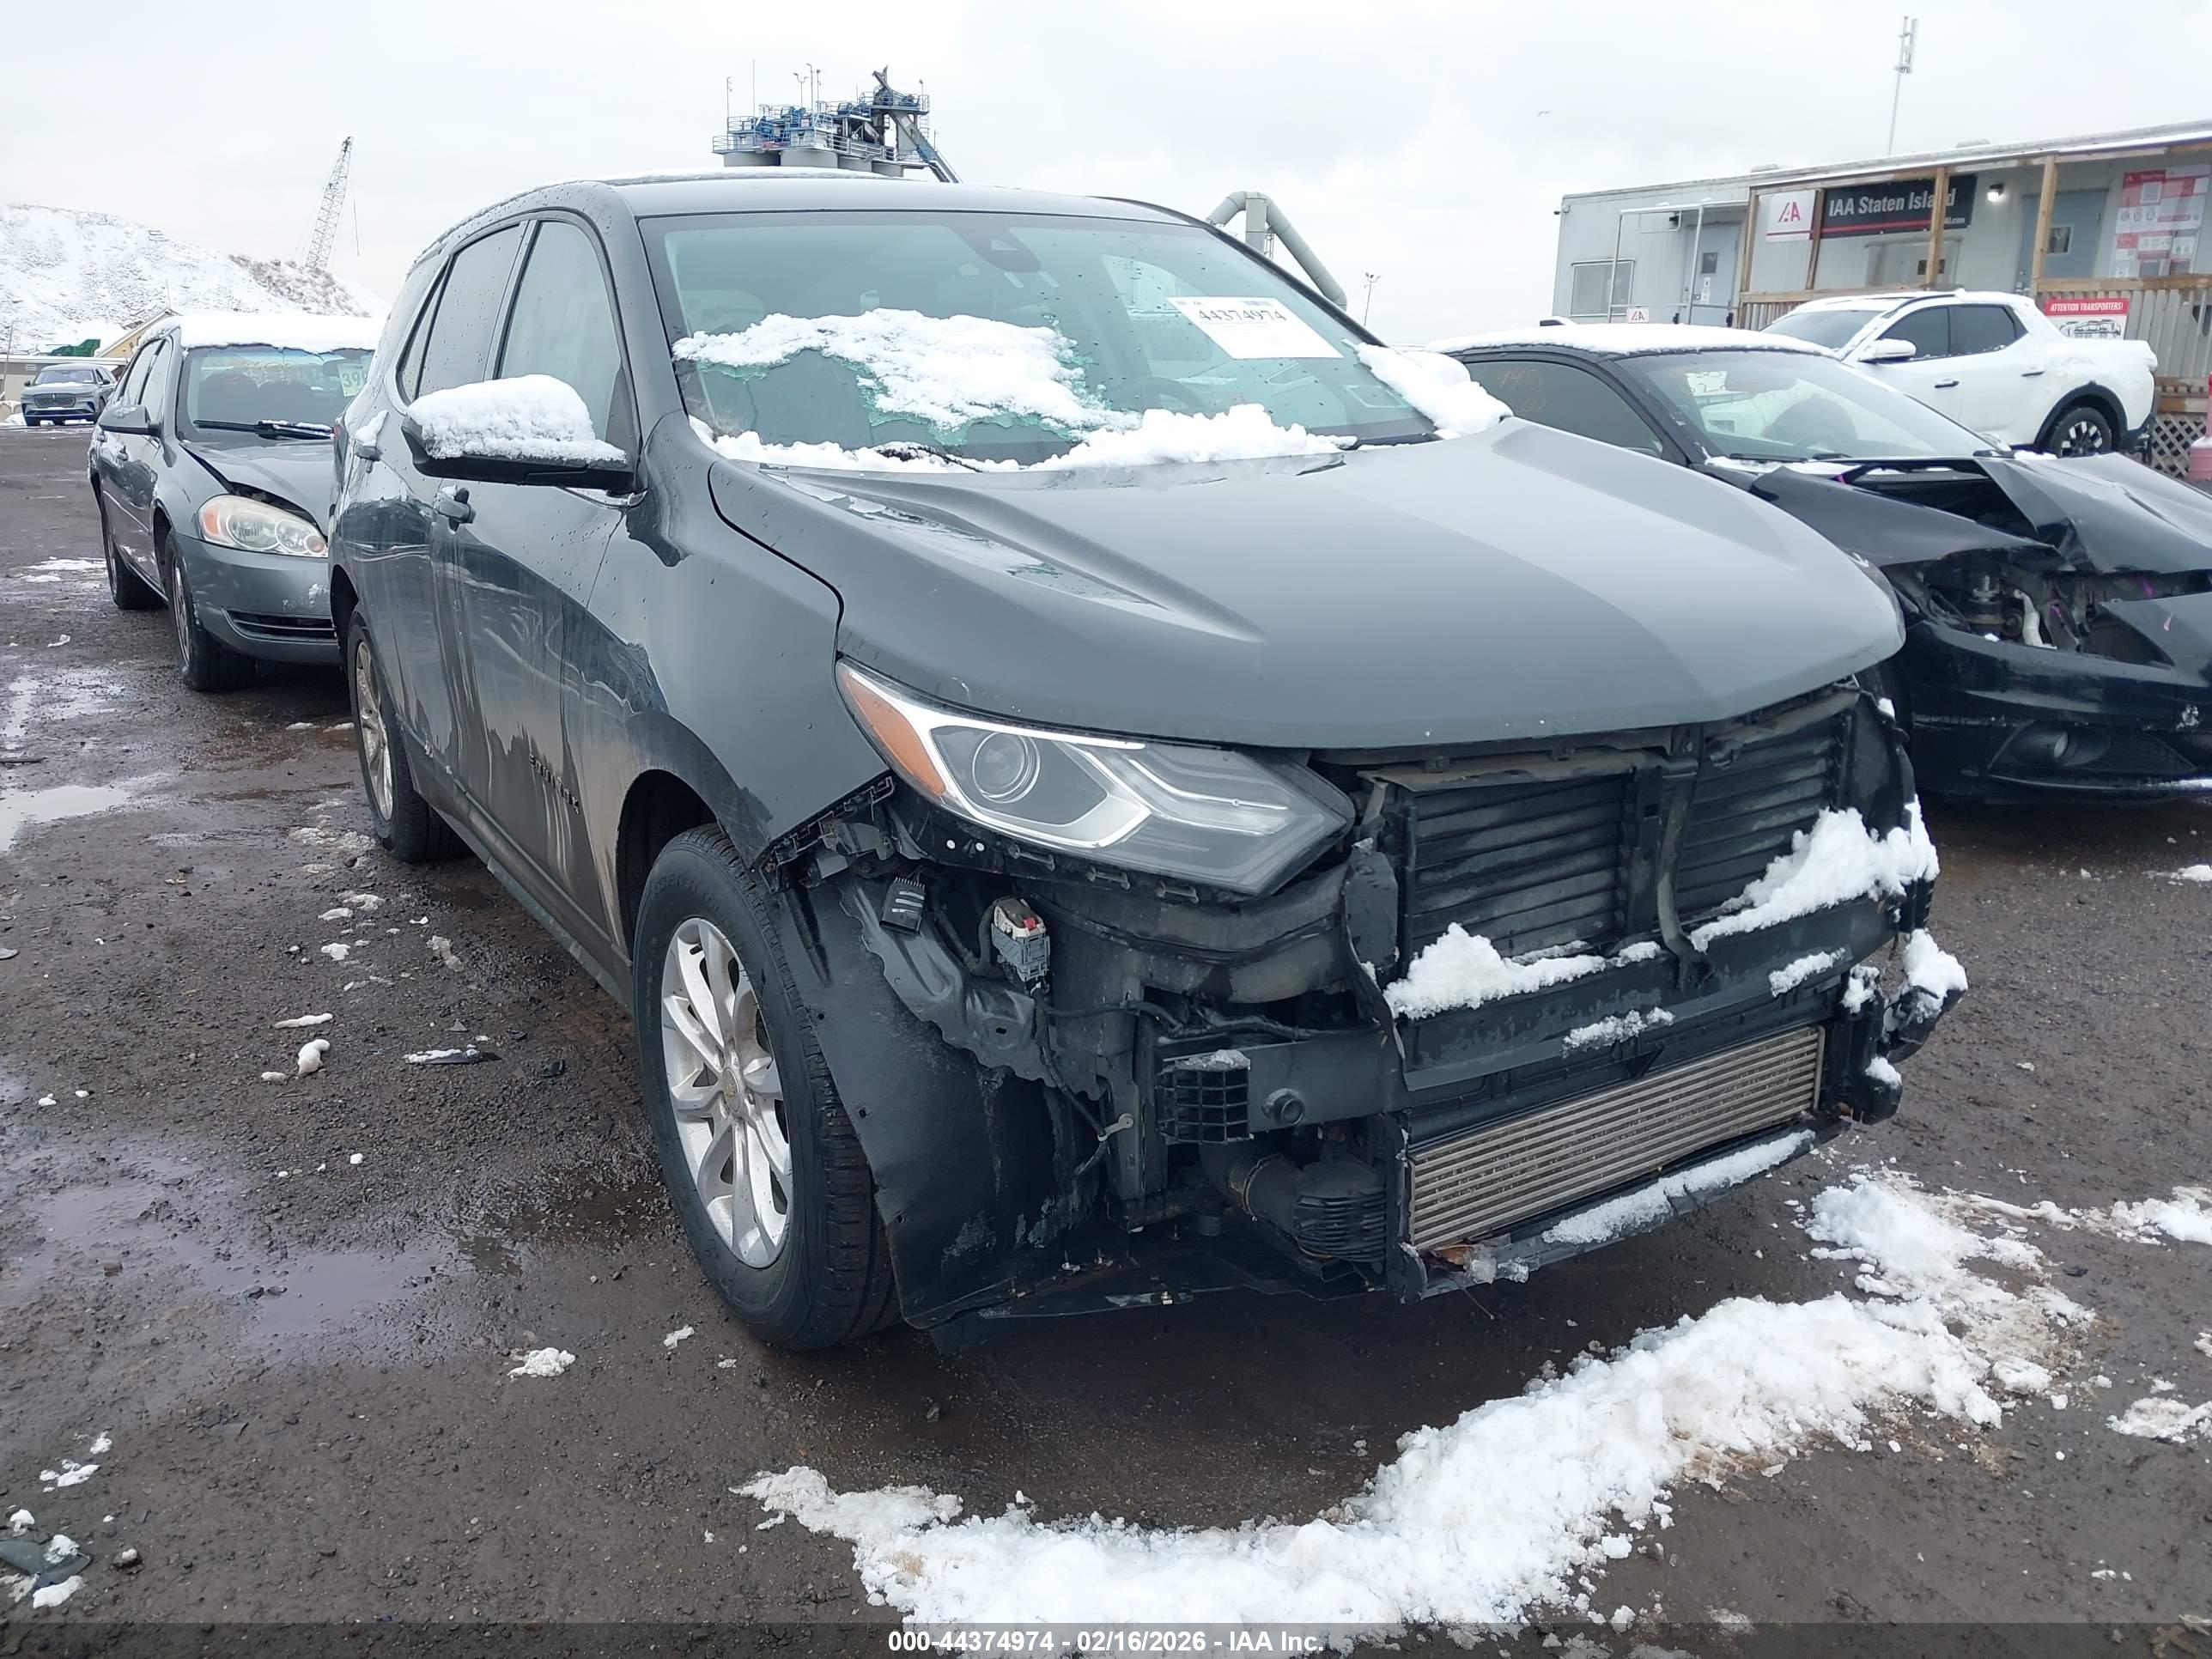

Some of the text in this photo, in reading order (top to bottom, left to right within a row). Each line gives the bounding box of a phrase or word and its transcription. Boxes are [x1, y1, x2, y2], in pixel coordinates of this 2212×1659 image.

[1829, 187, 1956, 217] IAA Staten Islad
[2050, 302, 2124, 313] ATTENTION TRANSPORTERS!
[1199, 310, 1287, 321] 44374974
